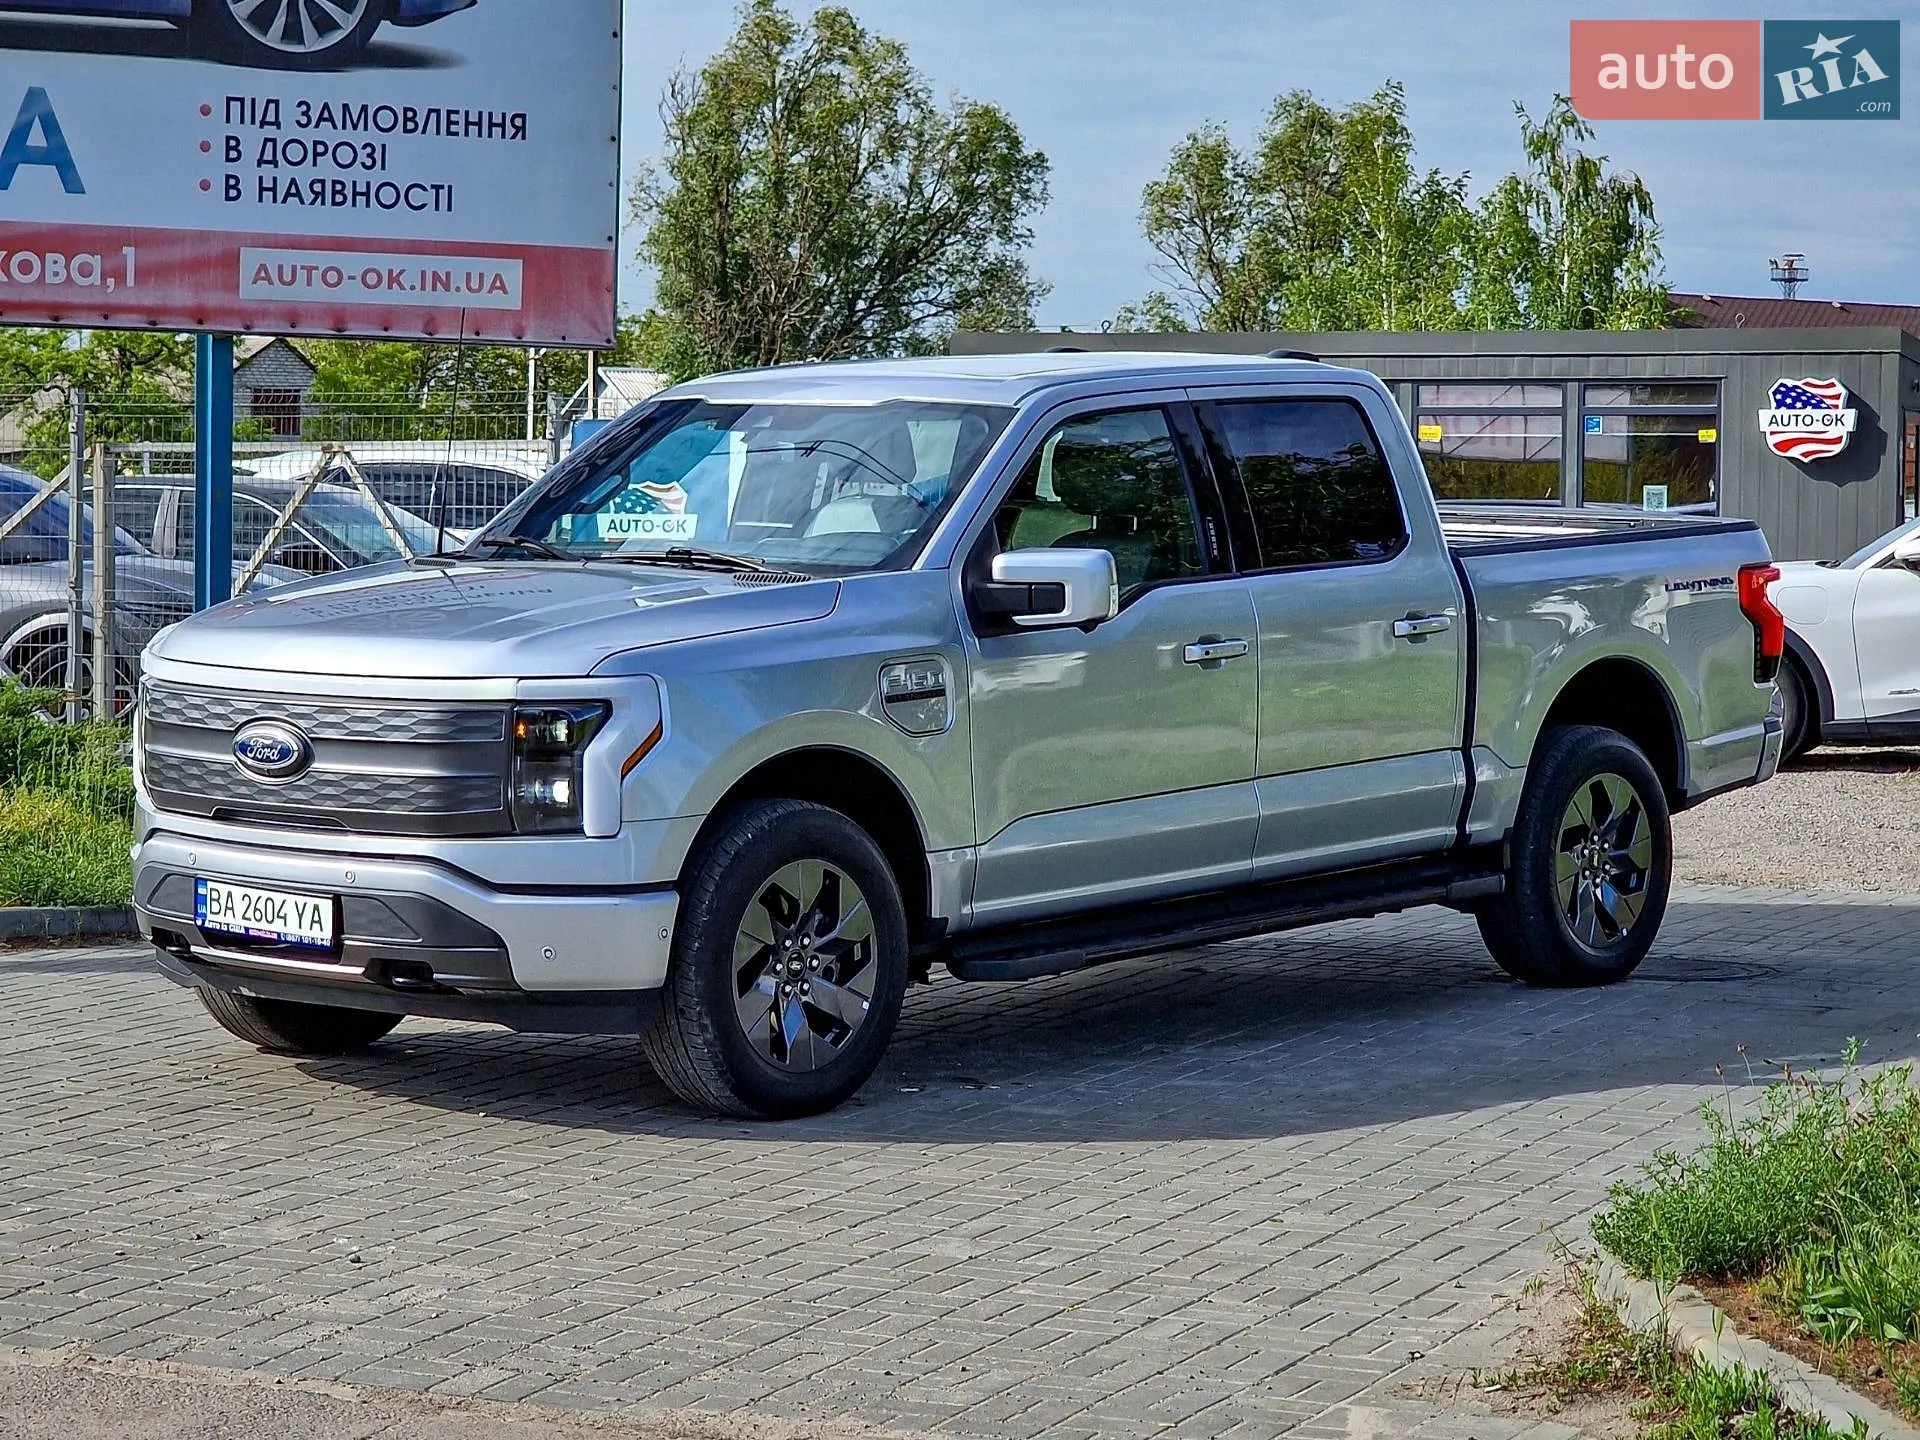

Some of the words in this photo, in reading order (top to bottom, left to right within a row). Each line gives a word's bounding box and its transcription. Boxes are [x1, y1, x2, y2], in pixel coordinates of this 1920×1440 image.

[224, 96, 281, 130] ПІД
[295, 100, 529, 141] ЗАМОВЛЕННЯ
[223, 136, 243, 164] В
[257, 139, 387, 171] ДОРОЗІ
[223, 174, 243, 202] В
[257, 177, 454, 212] НАЯВНОСТІ
[250, 262, 510, 296] AUTO-OK.IN.UA
[1767, 413, 1846, 428] AUTO-OK
[606, 518, 688, 533] AUTO-OK
[246, 737, 282, 761] Ford
[209, 887, 236, 919] BA
[241, 893, 288, 928] 2604
[294, 900, 324, 933] YA
